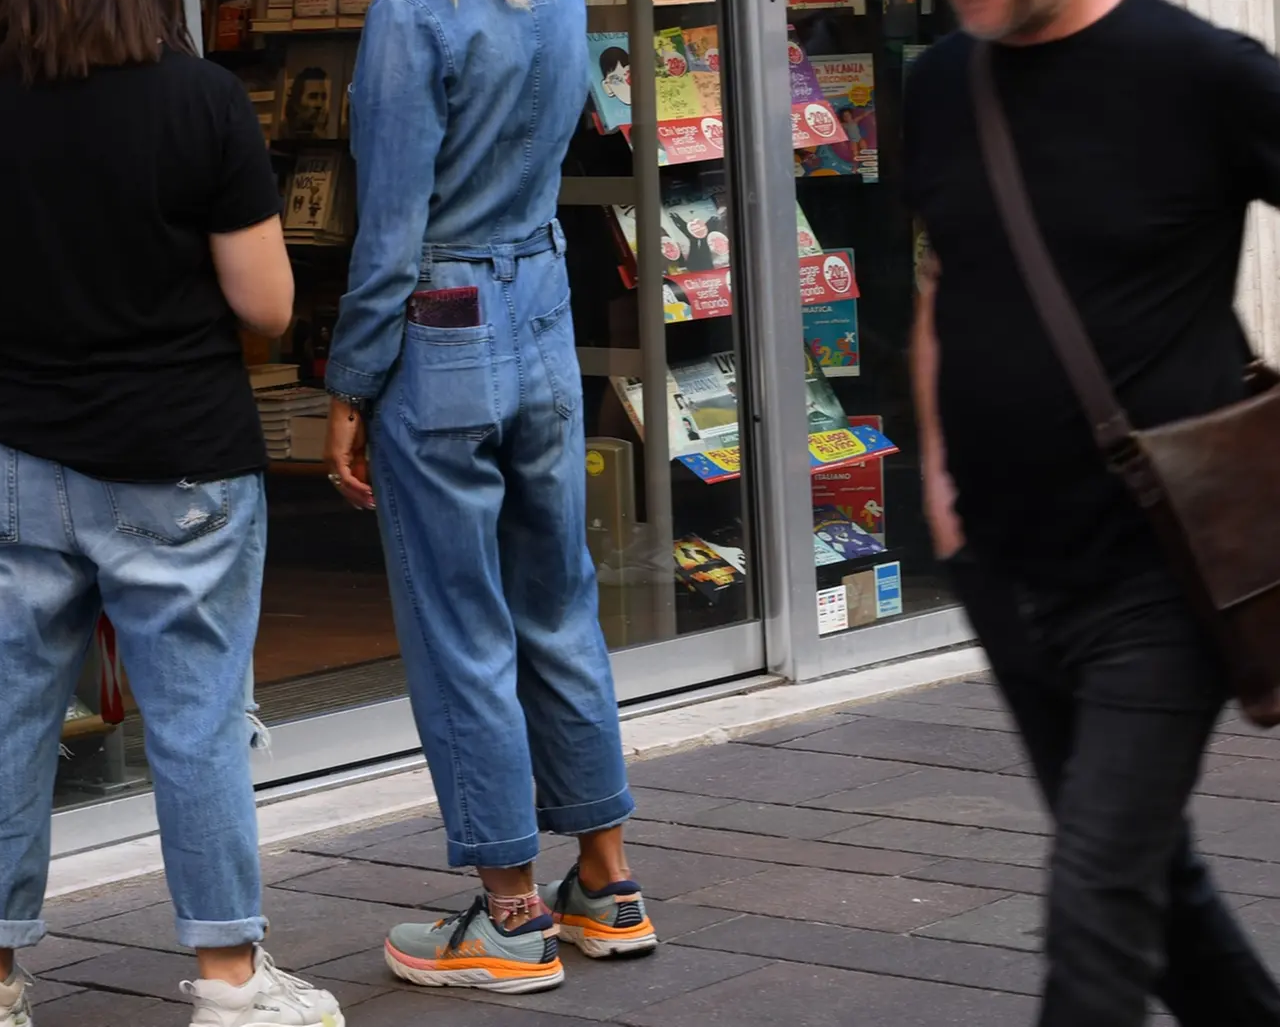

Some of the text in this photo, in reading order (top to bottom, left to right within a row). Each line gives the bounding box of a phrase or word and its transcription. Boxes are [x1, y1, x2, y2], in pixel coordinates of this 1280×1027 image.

[823, 63, 865, 74] VACANZA
[678, 143, 708, 155] mondo
[701, 298, 730, 310] mondo
[814, 473, 851, 481] ITALIANO
